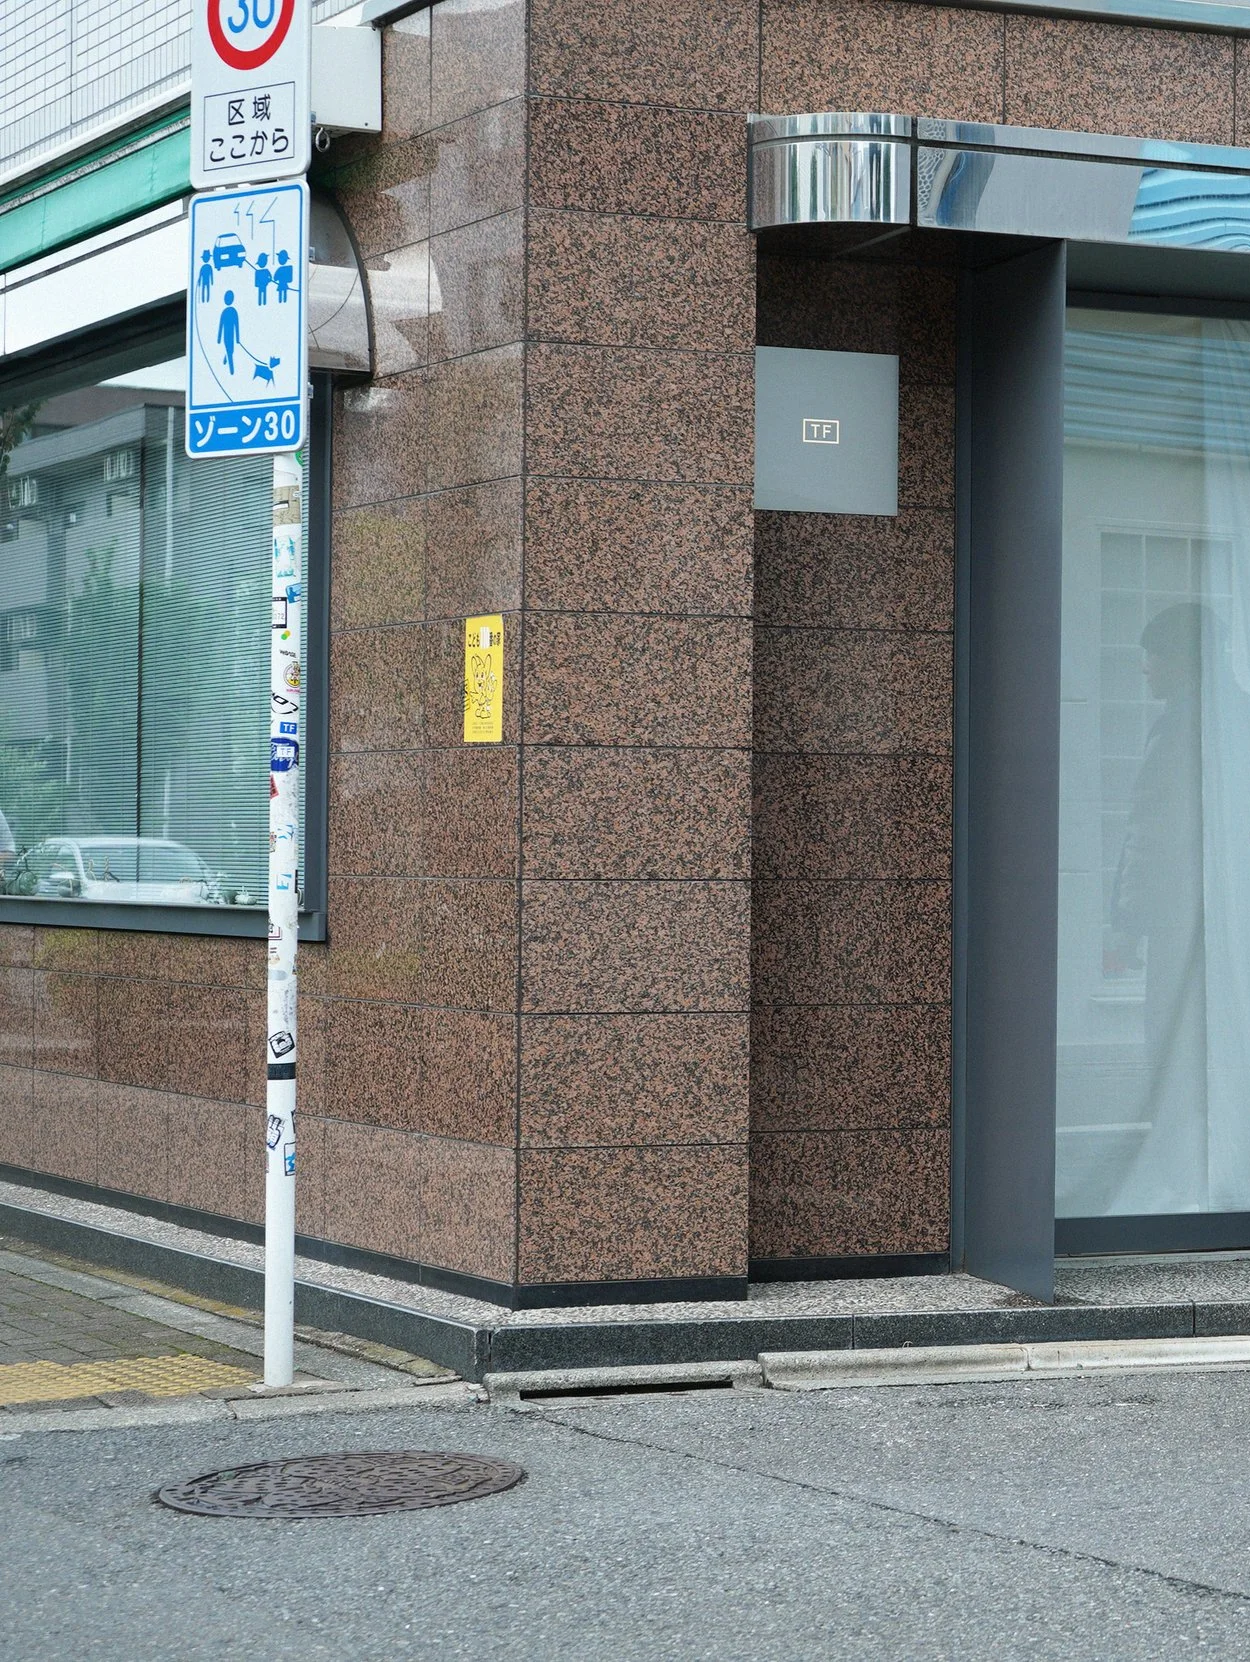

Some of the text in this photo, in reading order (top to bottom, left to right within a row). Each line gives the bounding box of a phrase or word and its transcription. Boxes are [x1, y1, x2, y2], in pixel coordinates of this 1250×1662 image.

[227, 93, 272, 126] 区域
[209, 127, 290, 163] ここから
[195, 411, 295, 448] ゾーン30
[811, 424, 832, 438] TF
[283, 723, 296, 733] TF
[280, 747, 292, 756] TF
